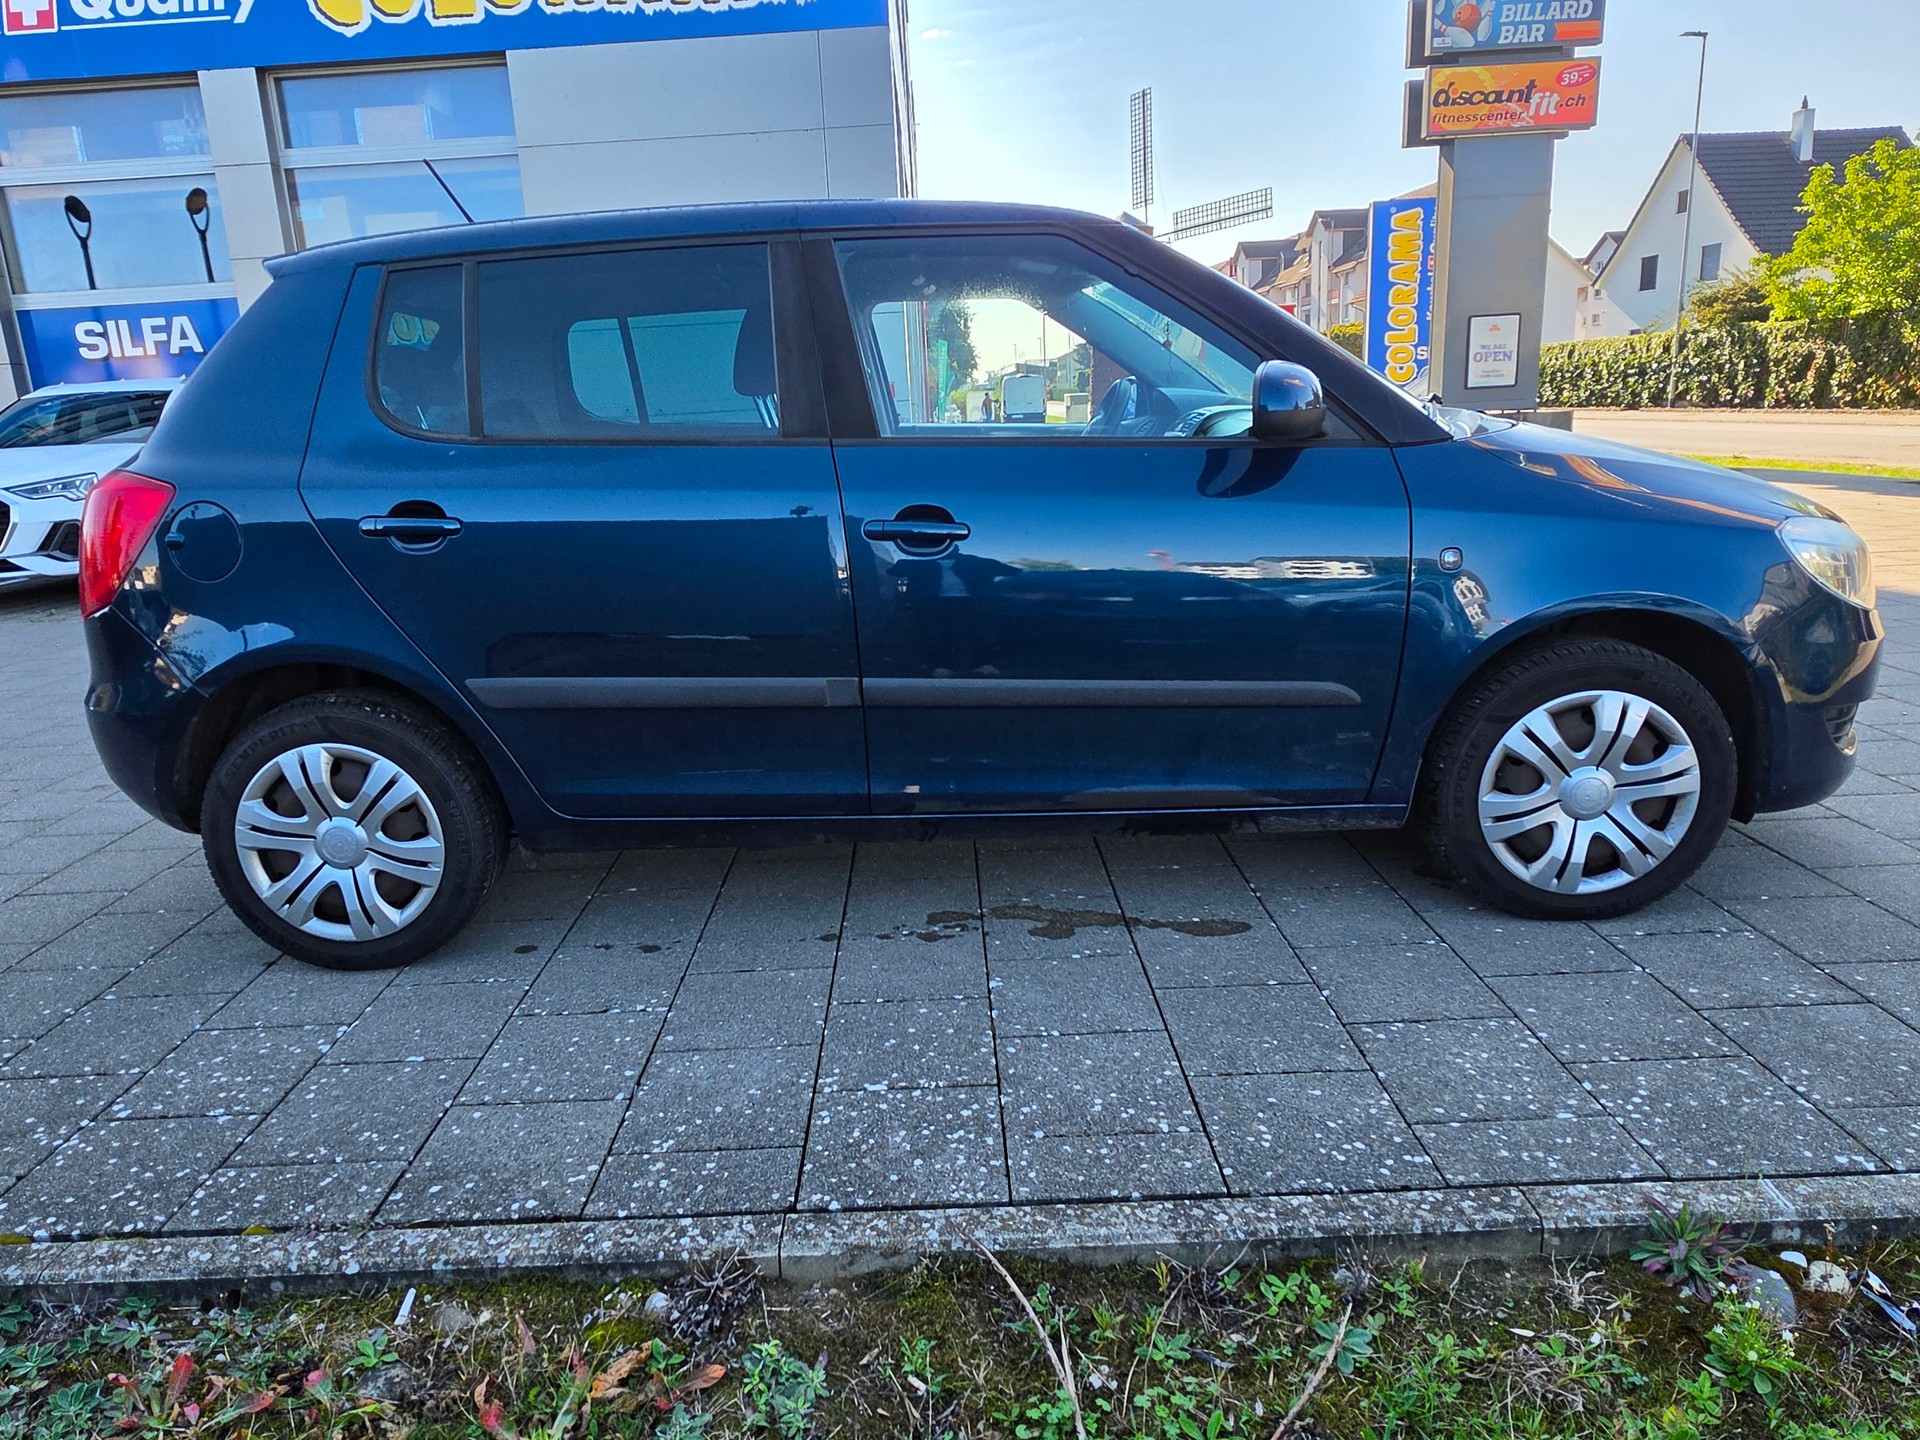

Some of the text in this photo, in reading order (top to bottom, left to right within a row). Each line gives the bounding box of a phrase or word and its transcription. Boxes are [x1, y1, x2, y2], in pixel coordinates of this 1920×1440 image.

[1500, 0, 1593, 23] BILLARD
[1498, 24, 1546, 44] BAR
[1432, 110, 1524, 124] fitnesscenter
[74, 315, 204, 360] SILFA
[1473, 350, 1513, 363] OPEN
